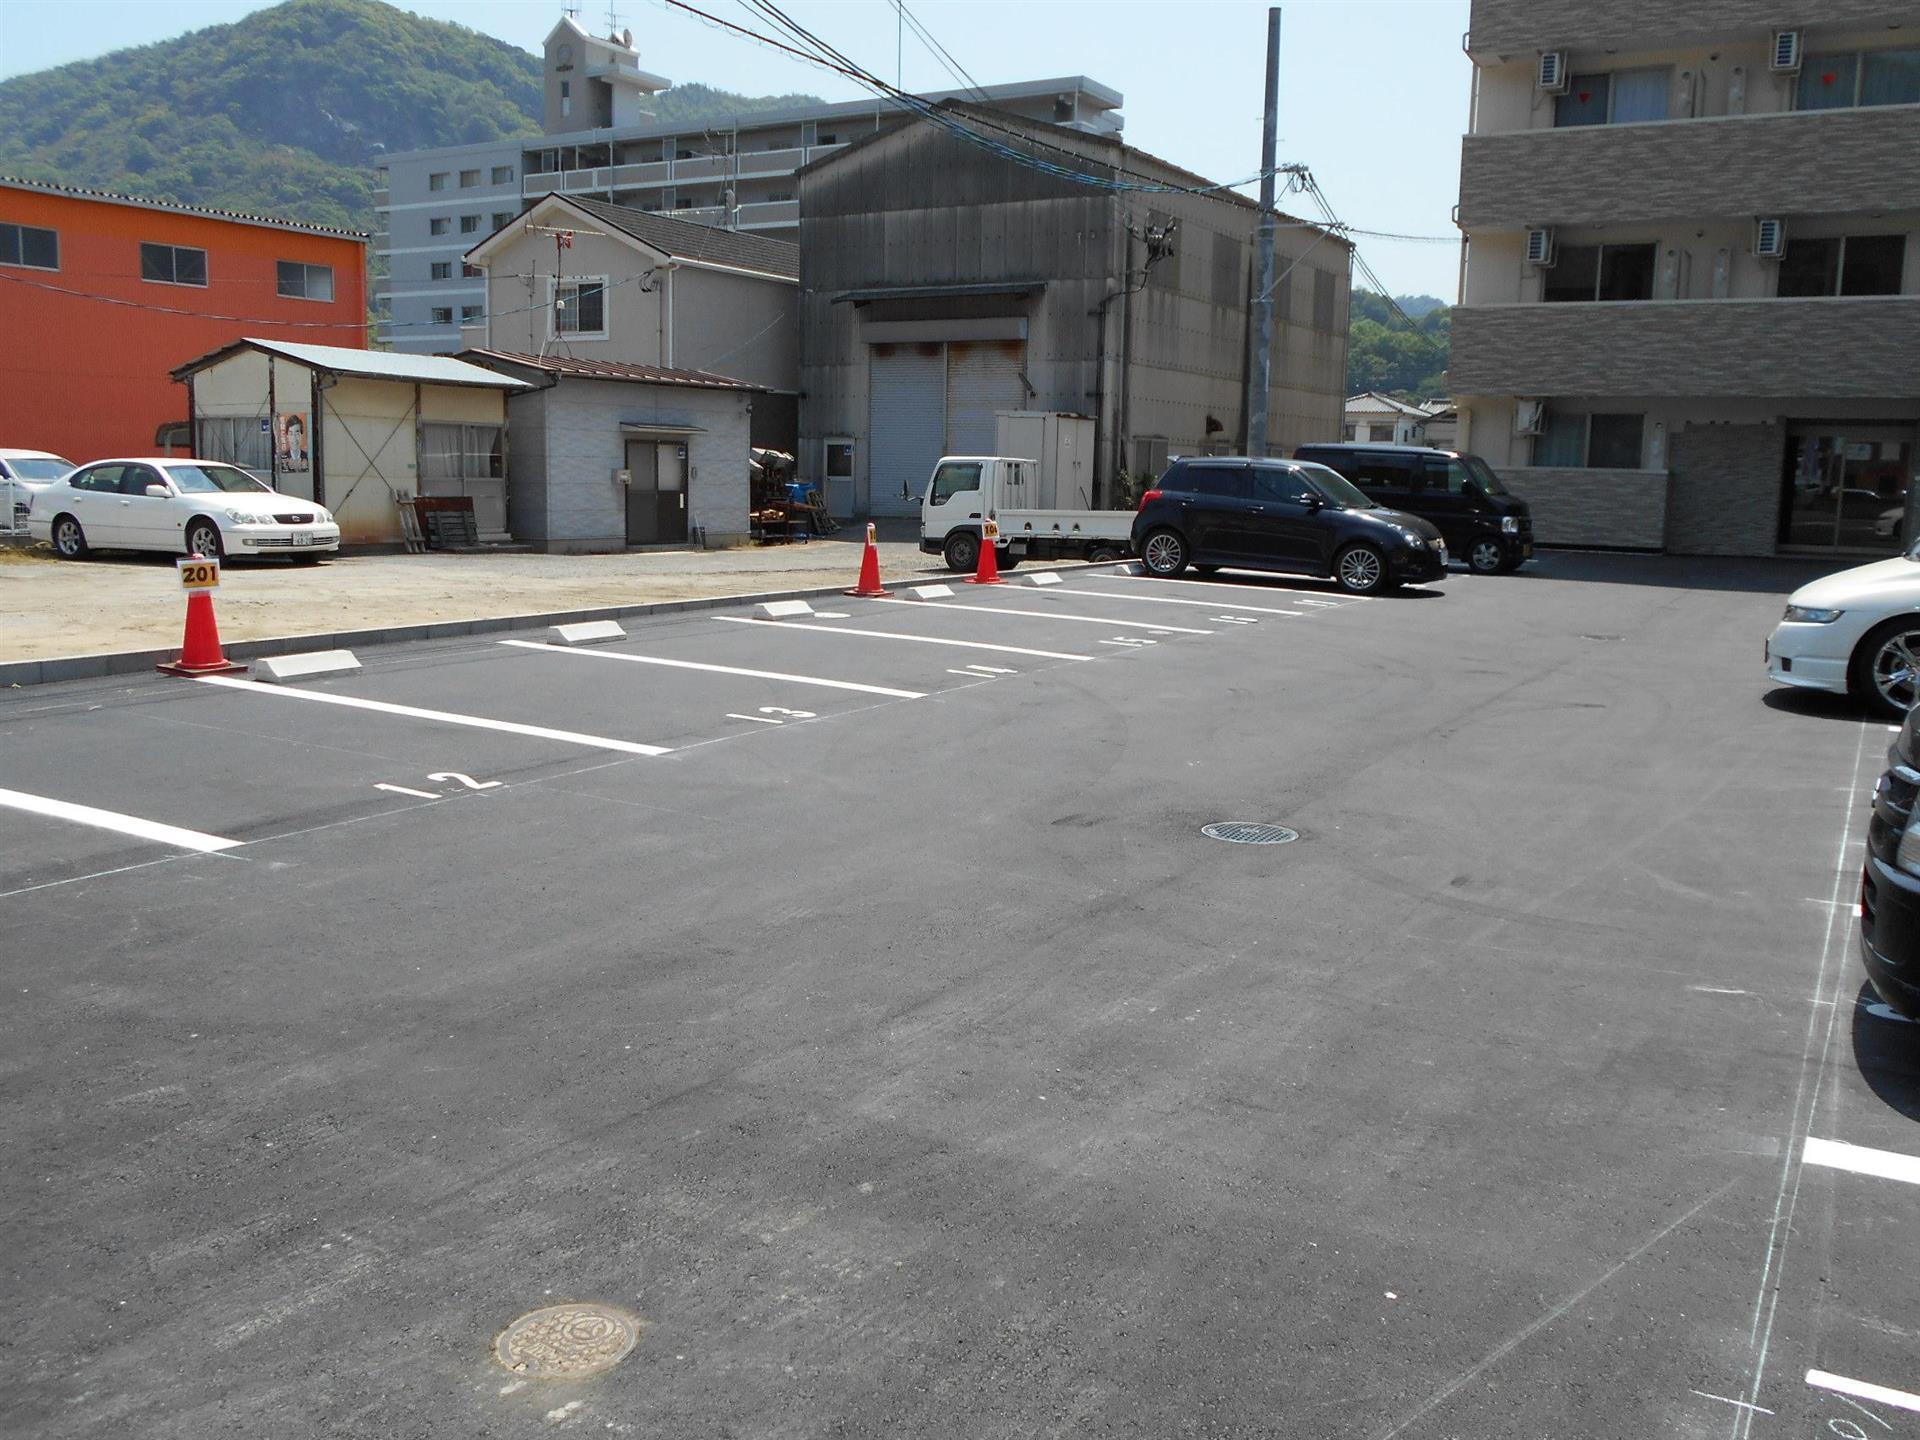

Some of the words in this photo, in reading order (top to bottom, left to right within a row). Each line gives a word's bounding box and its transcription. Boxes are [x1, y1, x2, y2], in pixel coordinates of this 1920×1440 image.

[183, 566, 215, 583] 201
[1097, 636, 1158, 647] 15
[945, 664, 1019, 678] 14
[725, 706, 818, 724] 13
[373, 772, 504, 800] 12
